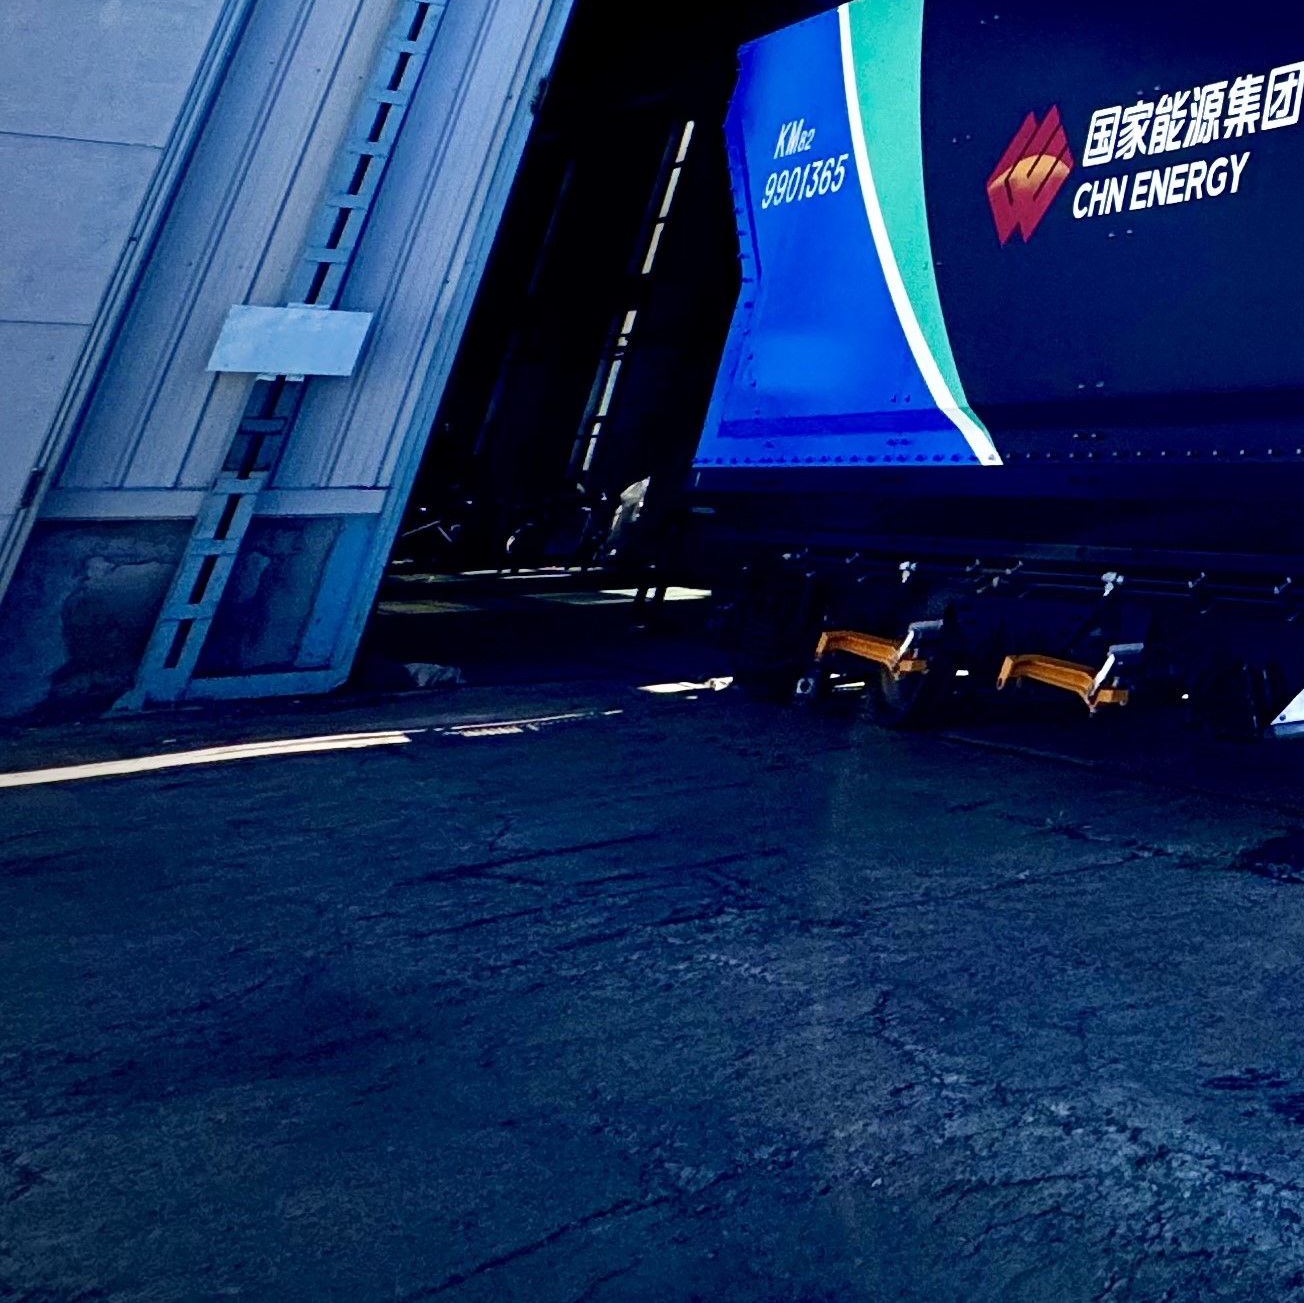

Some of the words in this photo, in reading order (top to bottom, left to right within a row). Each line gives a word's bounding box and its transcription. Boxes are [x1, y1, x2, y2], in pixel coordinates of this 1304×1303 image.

[761, 153, 849, 209] 9901365
[1072, 174, 1130, 219] CHN
[1129, 152, 1250, 211] ENERGY
